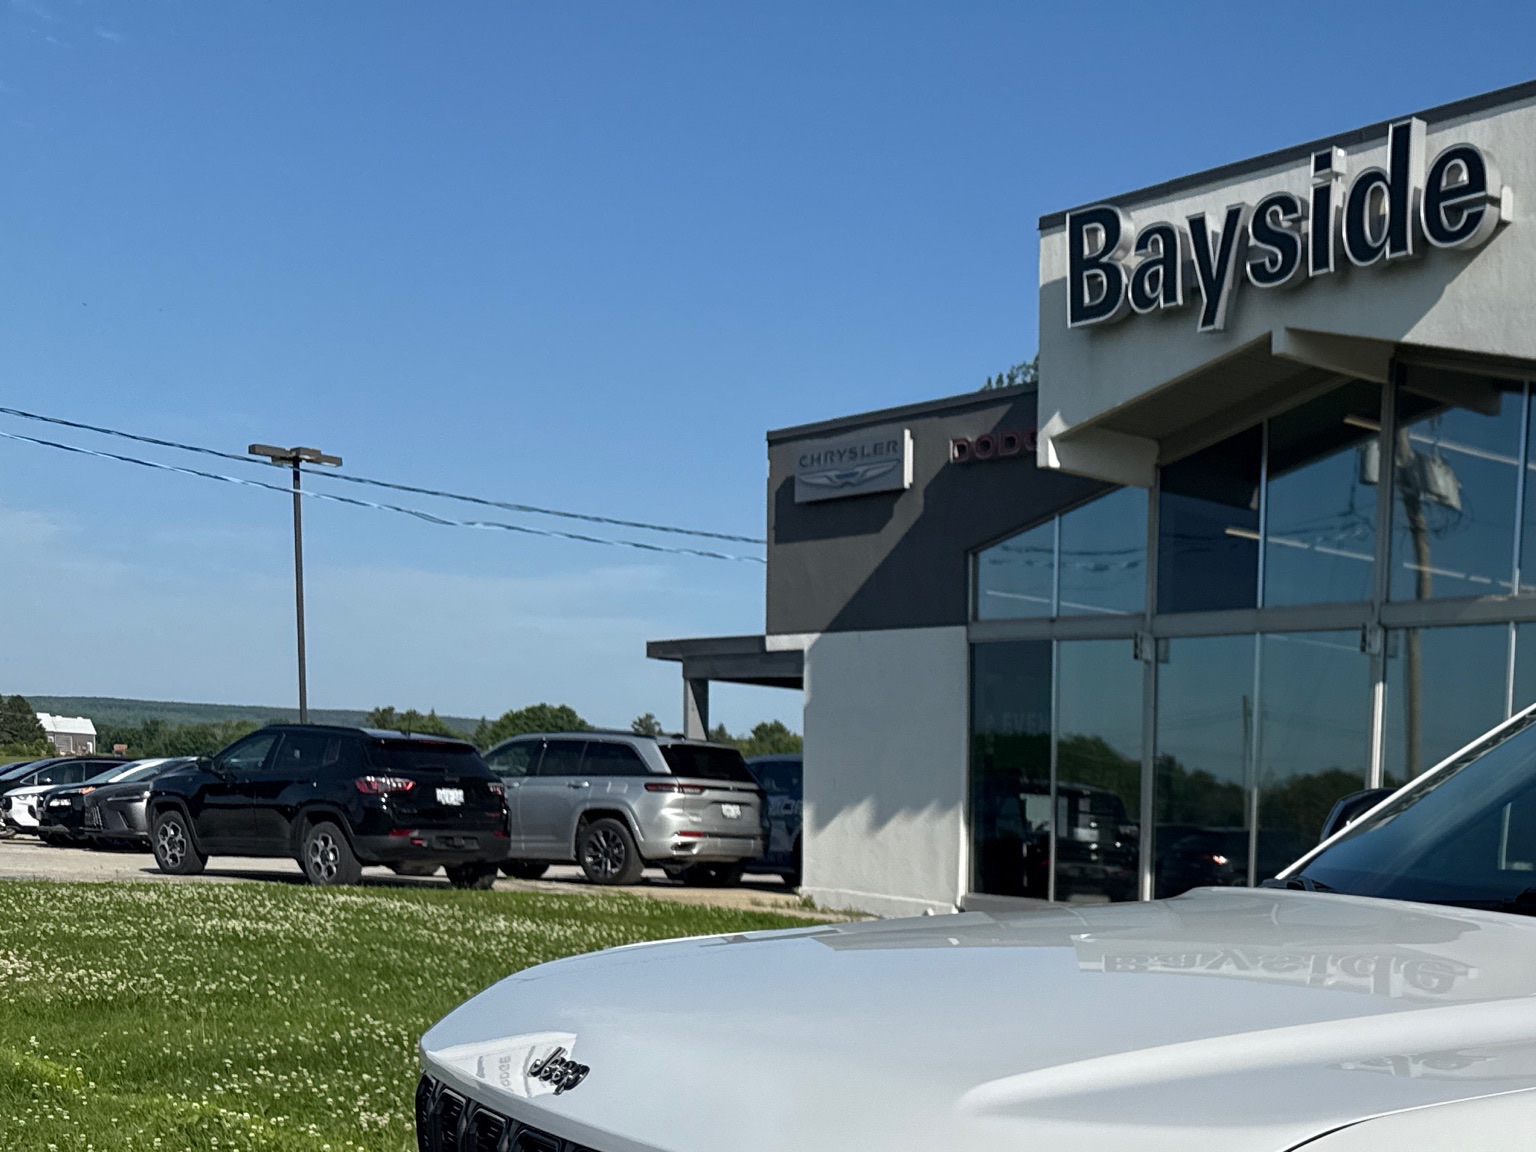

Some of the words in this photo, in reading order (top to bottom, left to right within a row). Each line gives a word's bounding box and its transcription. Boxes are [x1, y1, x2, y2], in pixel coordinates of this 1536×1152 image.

[1066, 117, 1504, 332] Bayside
[799, 438, 898, 468] CHRYSLER
[527, 1046, 590, 1095] Jeep
